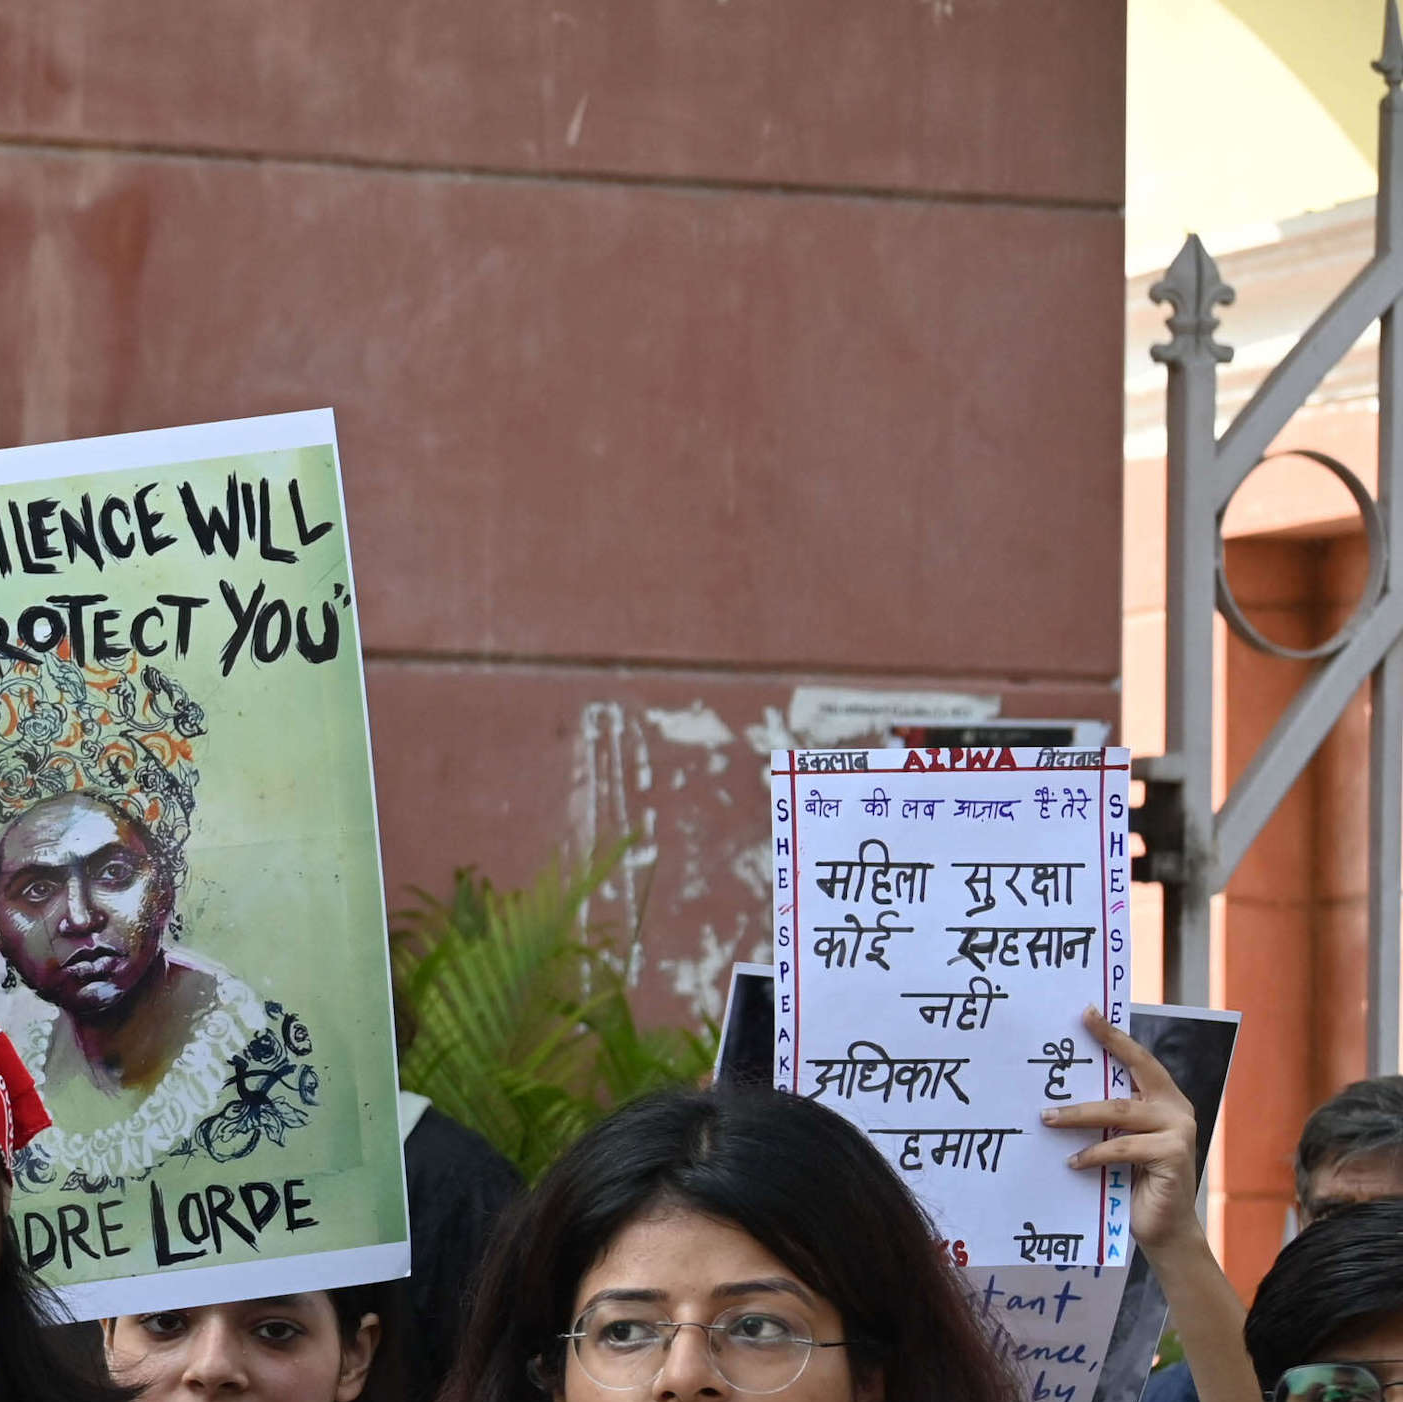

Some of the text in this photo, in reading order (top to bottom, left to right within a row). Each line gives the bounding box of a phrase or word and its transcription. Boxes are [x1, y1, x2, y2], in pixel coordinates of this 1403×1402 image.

[175, 470, 335, 565] WILL
[903, 747, 1019, 773] AIPWA
[814, 838, 1087, 918] महिला सुरक्षा
[813, 910, 915, 971] कोई
[900, 976, 1009, 1031] नहीं
[804, 1037, 1094, 1105] अधिकार है
[867, 1128, 1024, 1173] हमारा
[22, 1178, 320, 1272] DRE LORDE
